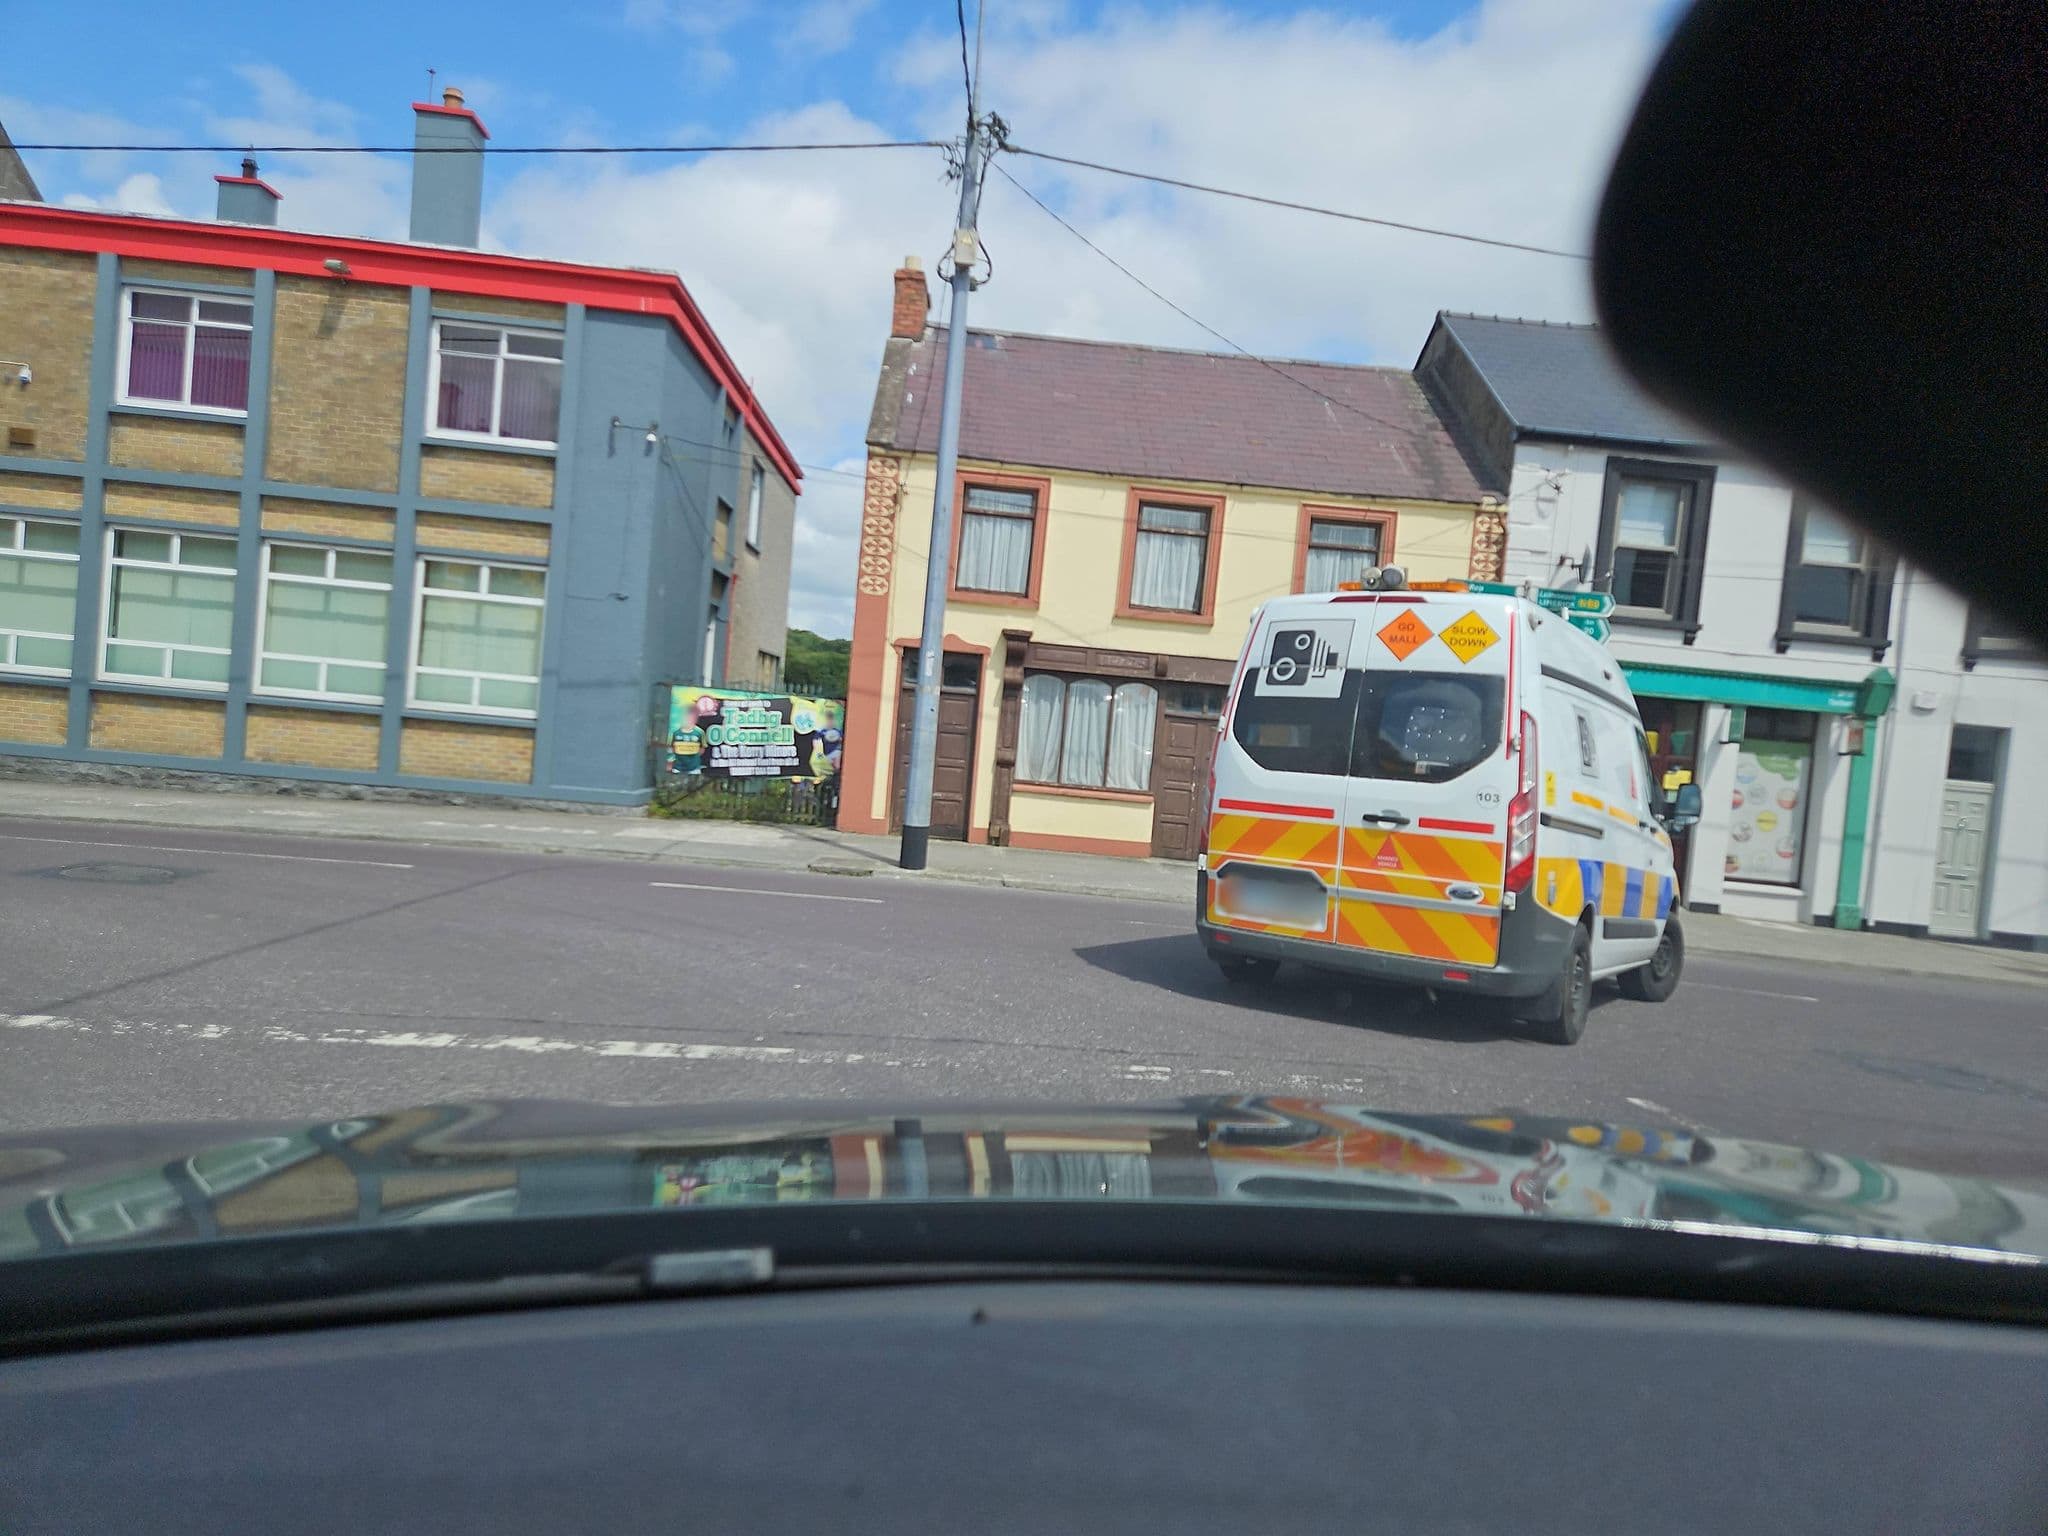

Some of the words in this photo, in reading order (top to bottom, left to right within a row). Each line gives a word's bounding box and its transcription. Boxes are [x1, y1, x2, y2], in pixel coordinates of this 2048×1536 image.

[1398, 622, 1415, 632] GO
[1452, 626, 1488, 636] SLOW
[1388, 635, 1418, 645] MALL
[1449, 637, 1488, 648] DOWN
[725, 709, 778, 728] Tadhg
[1478, 793, 1500, 803] 103
